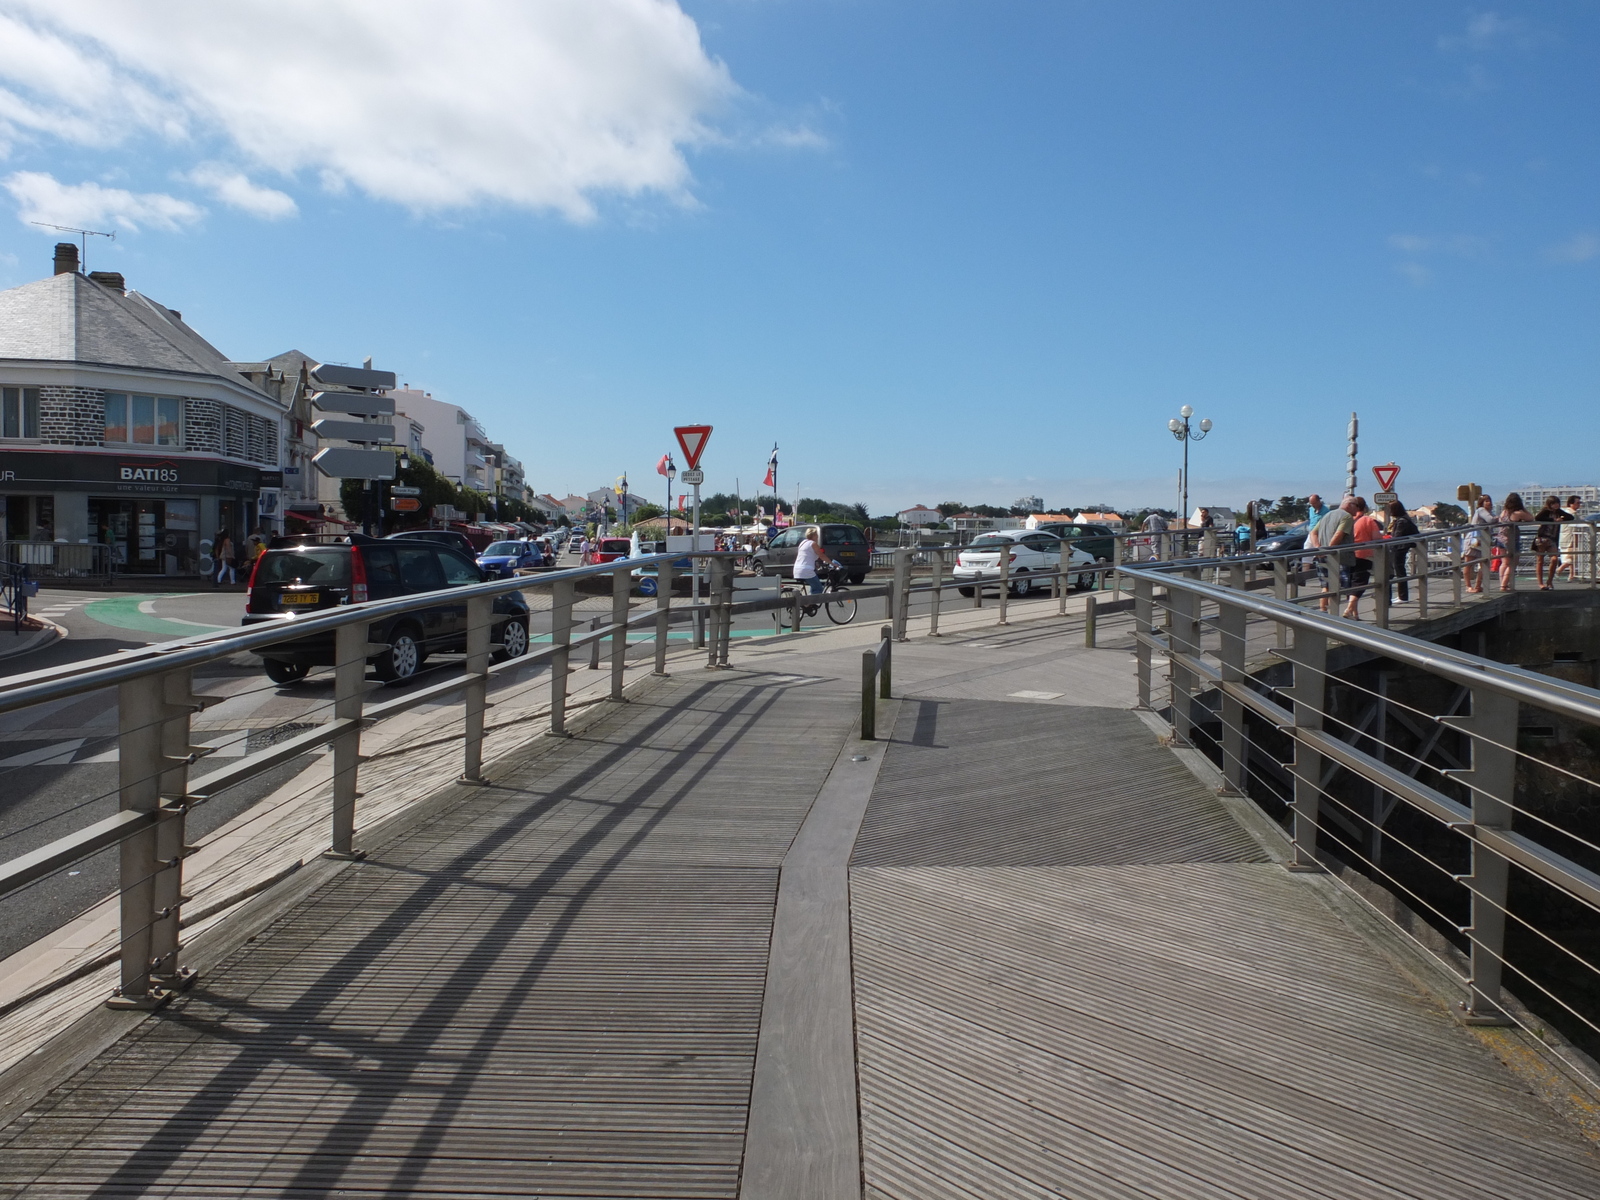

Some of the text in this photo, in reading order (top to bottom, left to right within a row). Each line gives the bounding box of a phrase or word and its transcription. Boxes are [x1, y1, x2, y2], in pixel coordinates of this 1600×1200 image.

[120, 467, 178, 482] BATI85
[134, 484, 159, 492] valeur
[300, 594, 308, 603] TY
